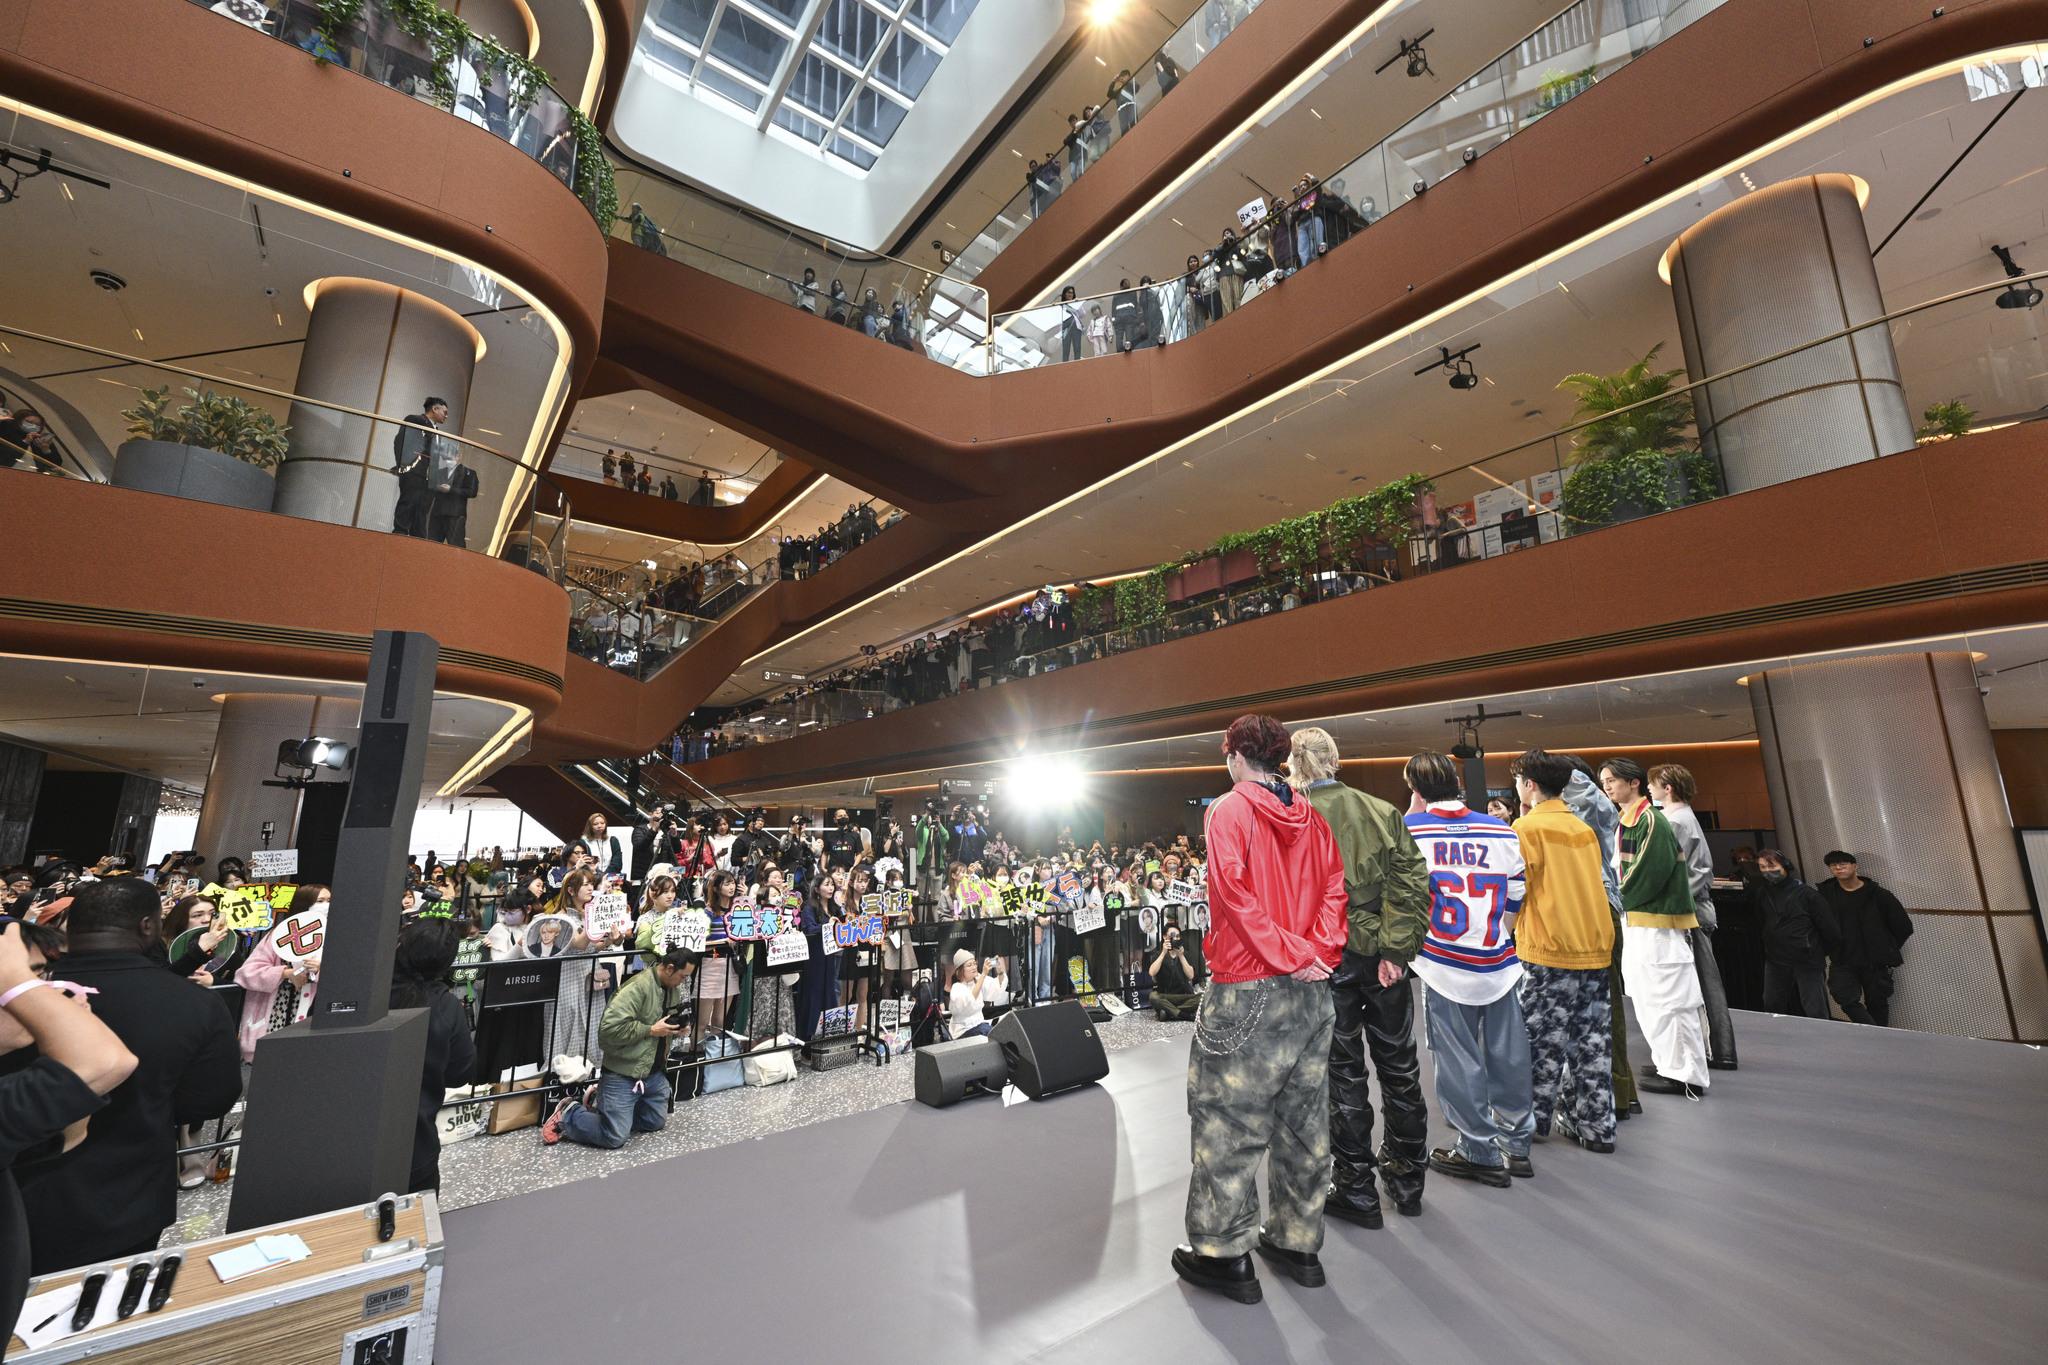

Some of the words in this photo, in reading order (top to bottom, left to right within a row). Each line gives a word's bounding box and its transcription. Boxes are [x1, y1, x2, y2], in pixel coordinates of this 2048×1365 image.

[764, 671, 771, 680] 3
[1433, 841, 1490, 869] RAGZ
[1427, 870, 1508, 947] 67
[731, 909, 778, 938] 元太
[837, 916, 885, 945] げんた
[505, 975, 541, 985] AIRSIDE
[444, 1109, 482, 1132] SHOW
[368, 1293, 389, 1306] SHOW
[389, 1286, 407, 1299] BROS
